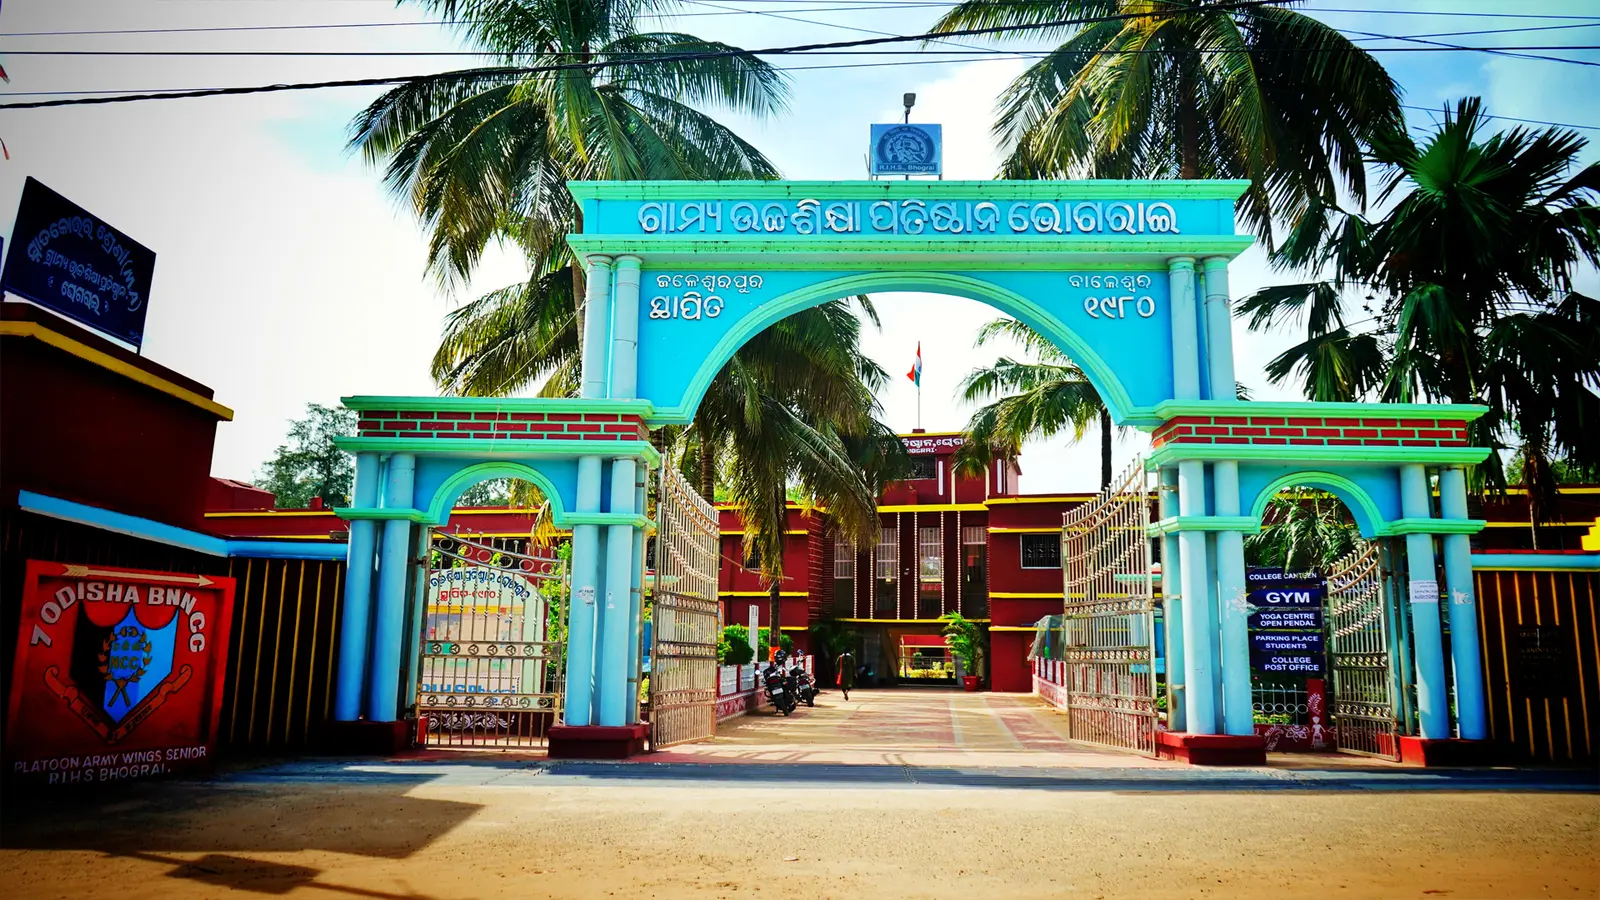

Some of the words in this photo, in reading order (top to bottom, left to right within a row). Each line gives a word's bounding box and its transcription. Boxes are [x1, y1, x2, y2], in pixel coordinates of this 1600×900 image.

[908, 164, 935, 172] Bhograi
[40, 581, 140, 625] ODISHA
[1266, 592, 1310, 603] GYM
[30, 623, 52, 648] 7
[14, 756, 81, 774] PLATOON
[83, 753, 119, 769] ARMY
[122, 750, 162, 764] WINGS
[166, 746, 207, 761] SENIOR
